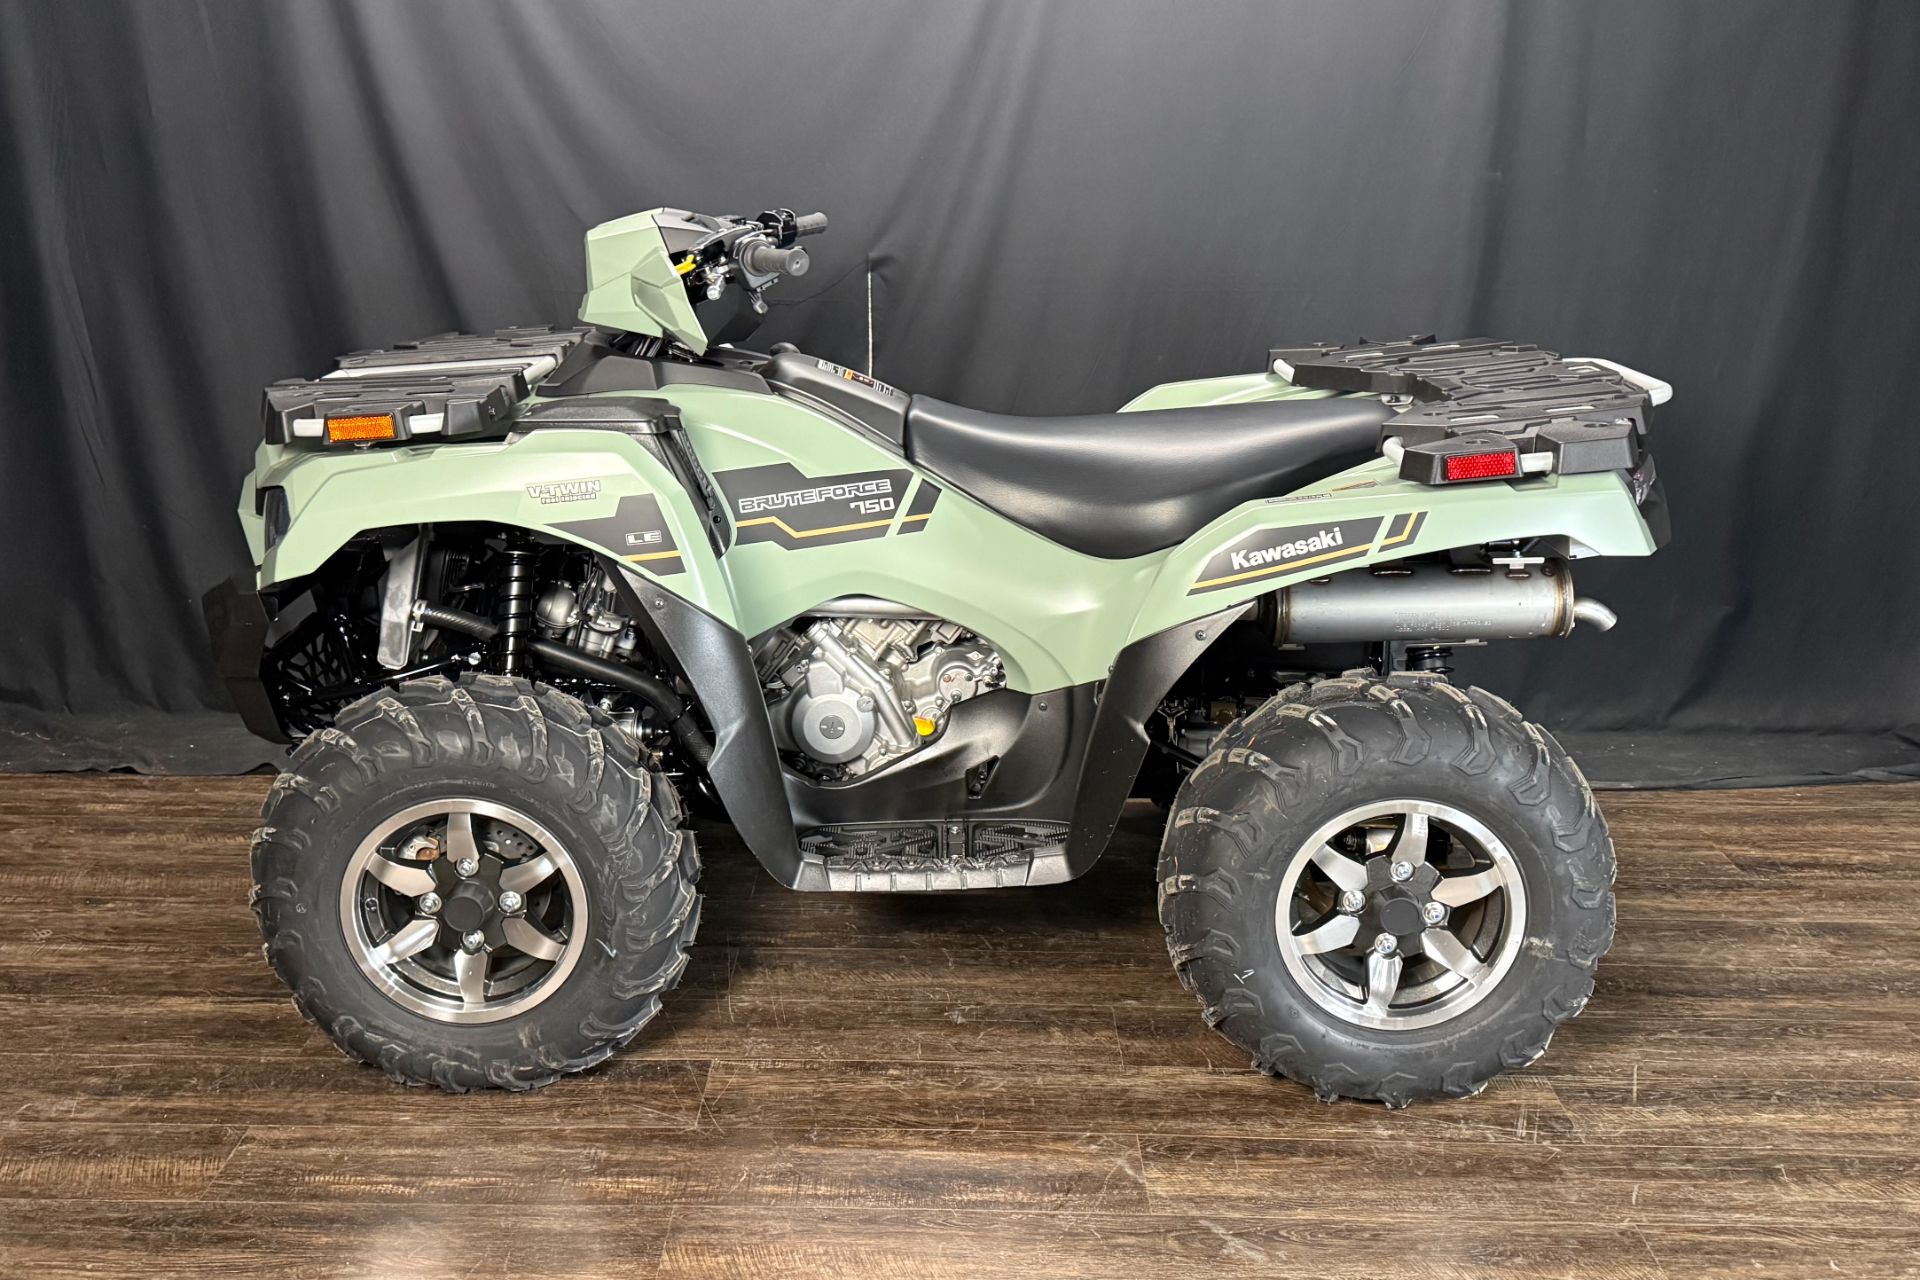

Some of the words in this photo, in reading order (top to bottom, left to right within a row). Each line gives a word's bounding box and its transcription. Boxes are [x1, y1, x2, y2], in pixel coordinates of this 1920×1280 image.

[526, 479, 601, 498] V-TWIN
[739, 488, 817, 514] BRUTE
[816, 479, 892, 503] FORCE
[849, 497, 895, 514] 750
[627, 531, 661, 545] LE
[1230, 526, 1344, 570] Kawasaki
